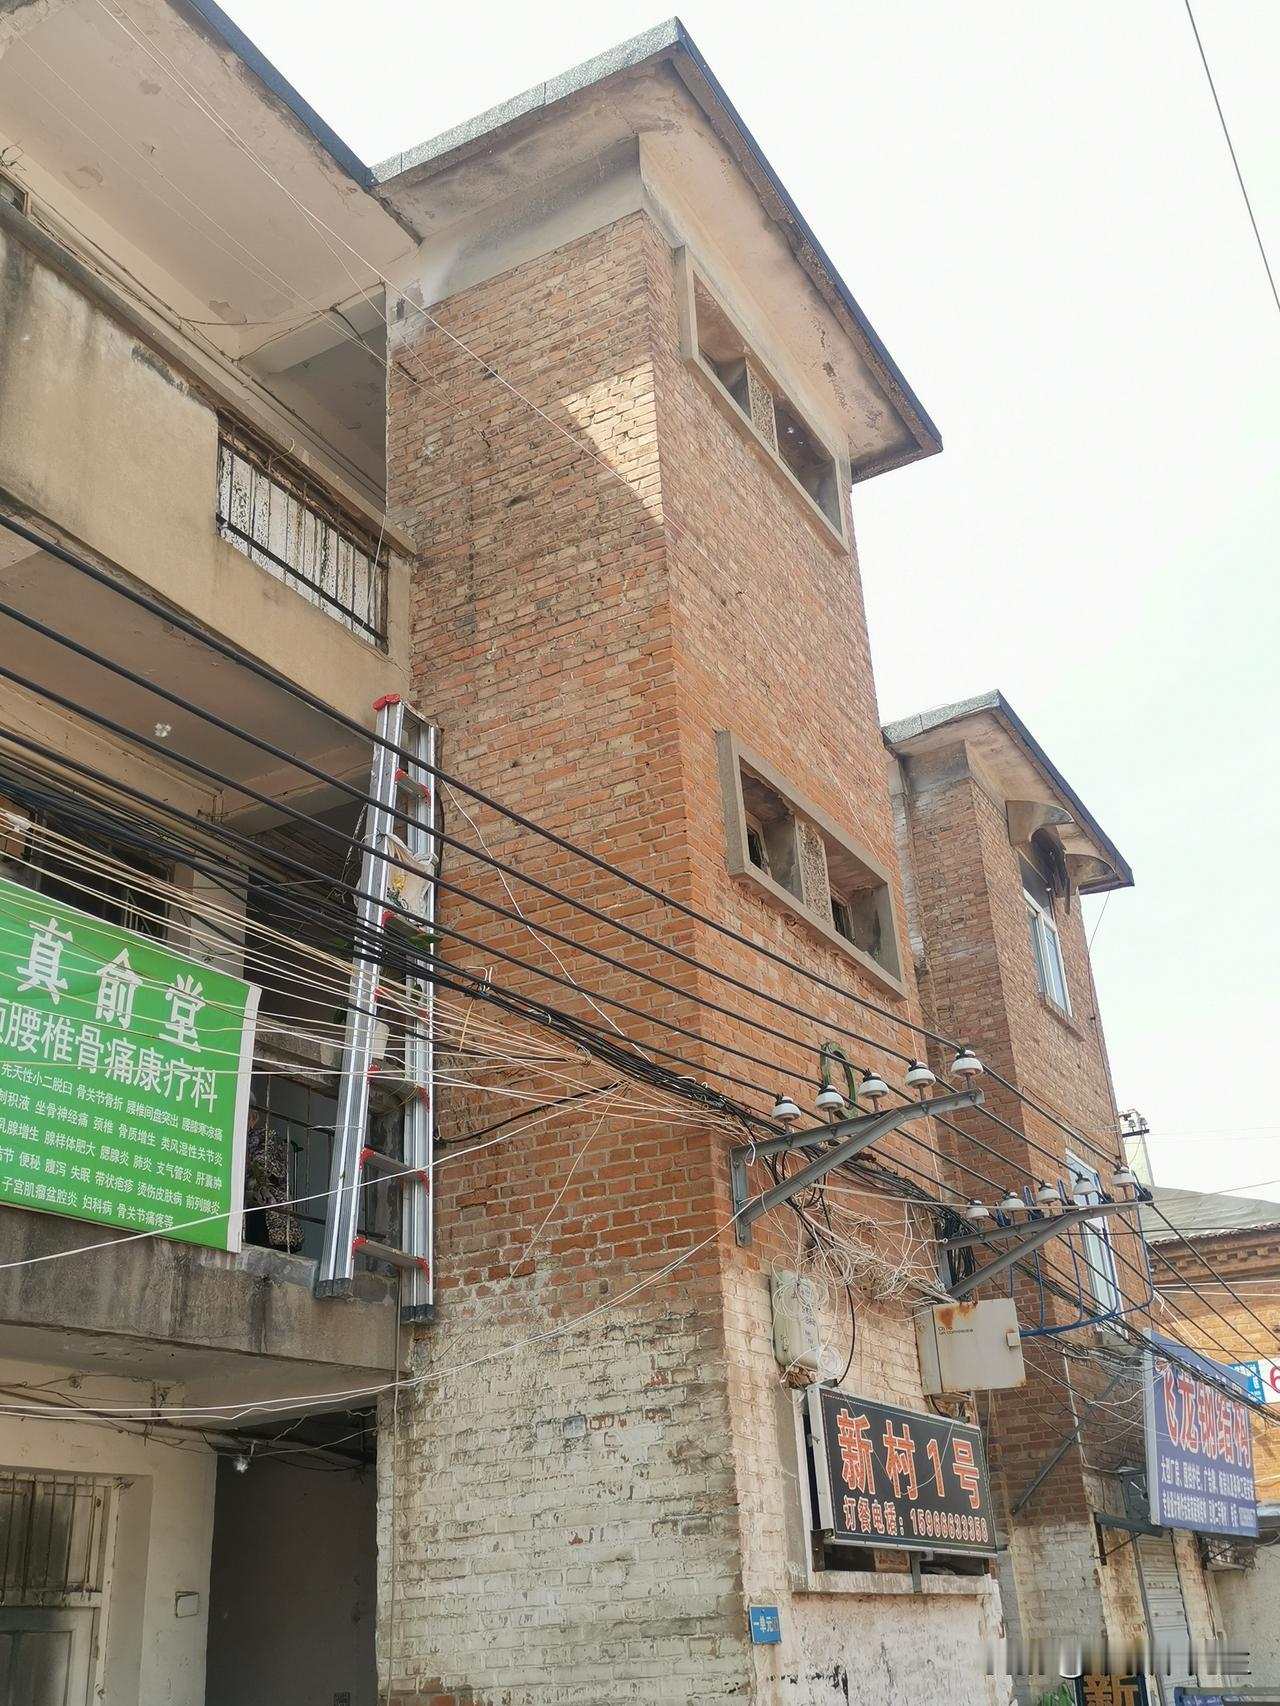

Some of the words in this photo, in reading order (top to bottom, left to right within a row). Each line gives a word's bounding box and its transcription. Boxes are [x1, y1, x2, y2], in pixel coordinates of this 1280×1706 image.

[35, 1100, 89, 1128] 坐骨神经痛
[93, 1116, 113, 1134] 颈椎
[118, 1123, 156, 1147] 骨质增生
[160, 1136, 223, 1167] 类风湿性关节炎
[76, 1084, 124, 1112] 骨关节骨折
[126, 1100, 179, 1129] 腰椎间盘突出
[19, 1151, 41, 1171] 便秘
[44, 1158, 67, 1177] 腹泻
[70, 1165, 91, 1184] 失眠
[137, 1181, 183, 1207] 烫伤皮肤病
[185, 1194, 220, 1216] 前列腺炎
[44, 1130, 96, 1157] 腺样体肥大
[132, 1154, 152, 1173] 肺炎
[156, 1162, 193, 1183] 支气管炎
[2, 1176, 78, 1208] 子宫肌瘤盆腔炎
[82, 1194, 113, 1217] 妇科病
[836, 1407, 981, 1510] 新村1号
